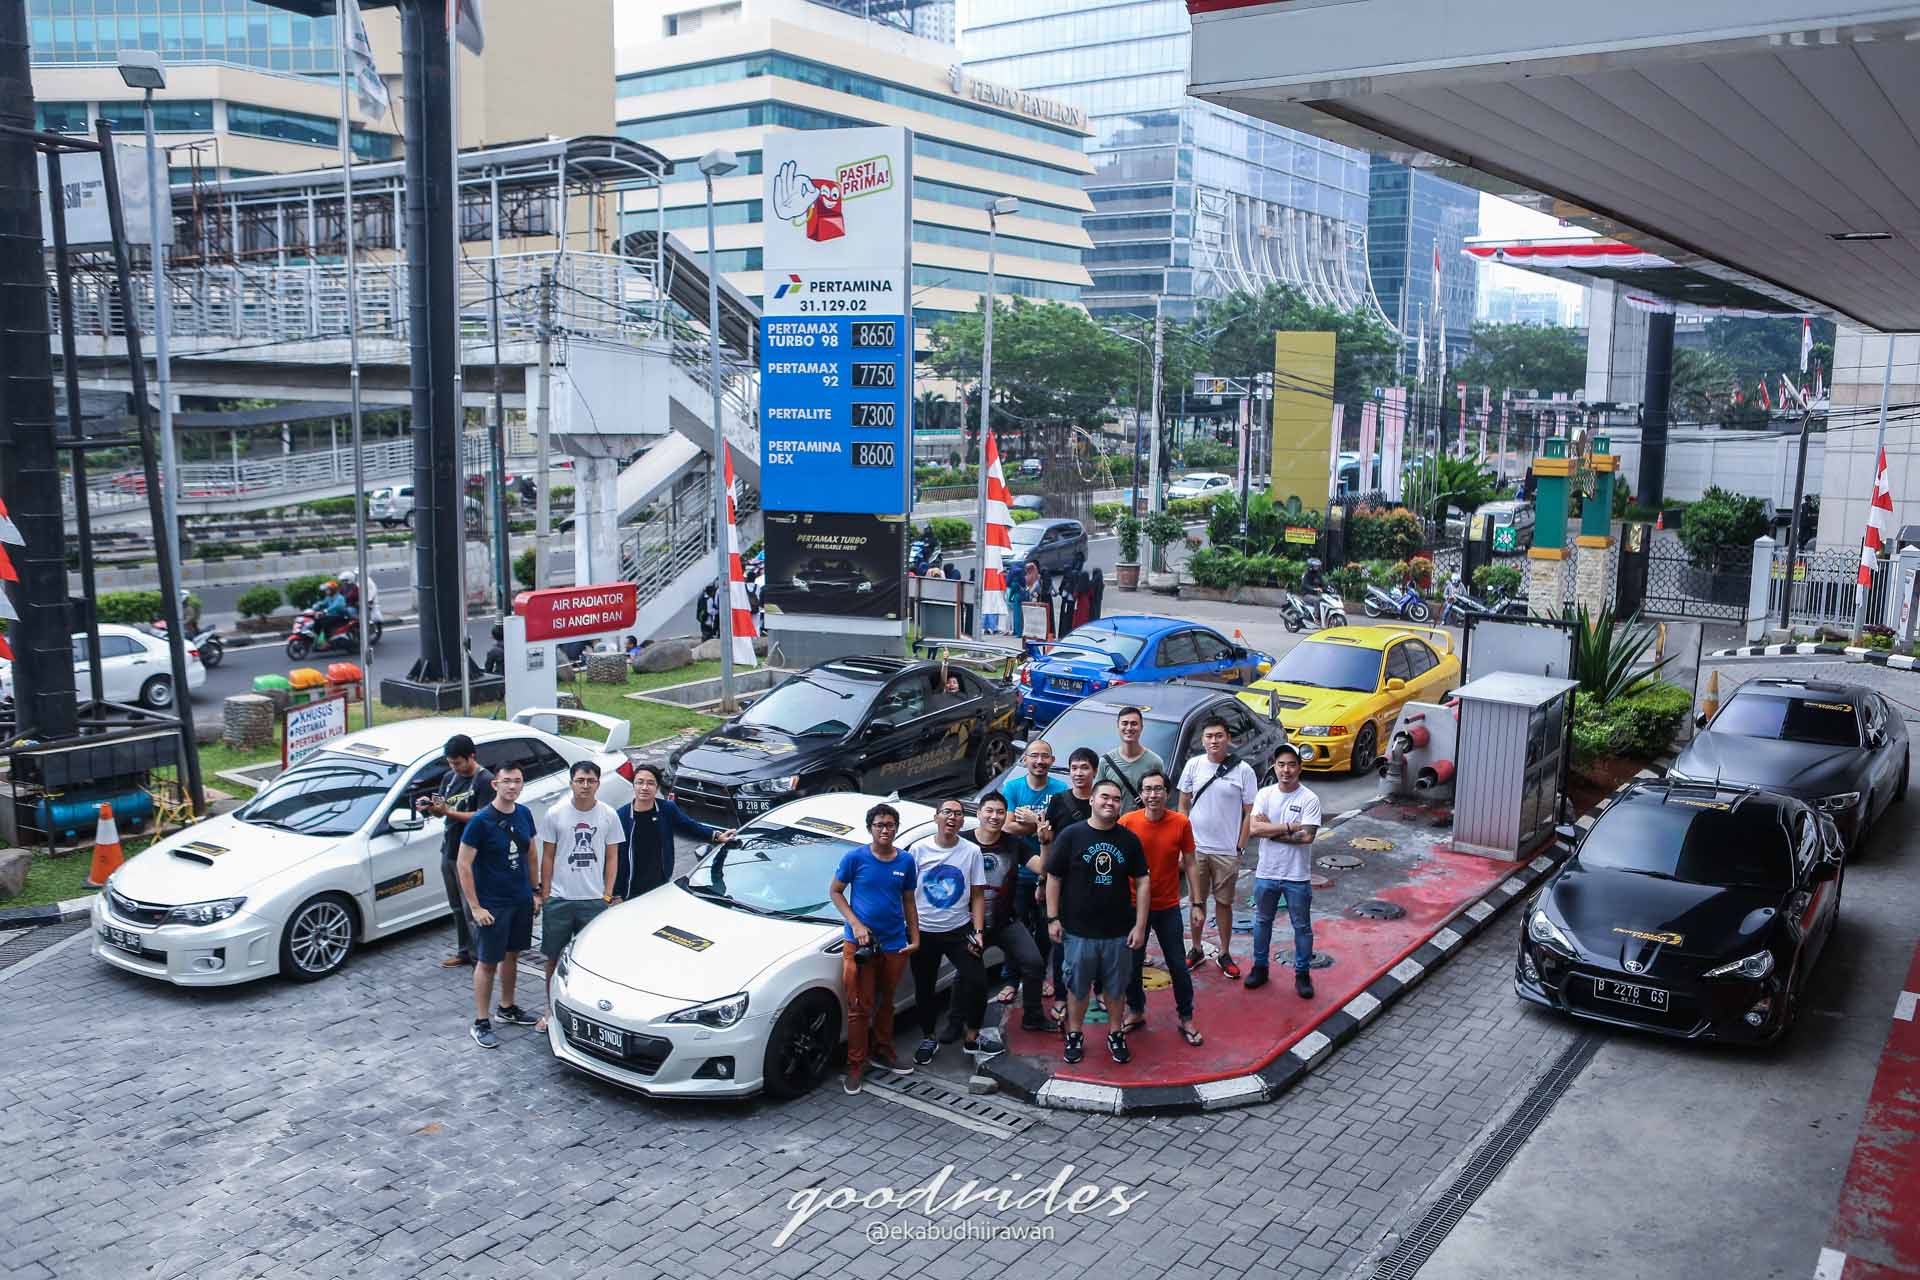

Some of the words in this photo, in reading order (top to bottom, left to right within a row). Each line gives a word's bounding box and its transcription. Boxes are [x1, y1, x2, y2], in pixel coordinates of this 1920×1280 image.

[840, 162, 876, 182] PASTI
[843, 170, 889, 194] PRIMA!
[810, 280, 892, 293] PERTAMINA
[800, 300, 866, 311] 31.129.02
[768, 323, 838, 334] PERTAMAX
[768, 335, 815, 347] TURBO
[822, 335, 838, 347] 98
[860, 326, 894, 346] 8650
[768, 363, 838, 374] PERTAMAX
[860, 365, 894, 385] 7750
[823, 376, 839, 387] 92
[768, 408, 832, 420] PERTALITE
[860, 405, 894, 425] 7300
[768, 441, 842, 453] PERTAMINA
[768, 454, 794, 464] DEX
[860, 445, 894, 465] 8600
[797, 535, 839, 543] PERTAMAX
[840, 536, 867, 544] TURBO
[552, 599, 570, 612] AIR
[572, 593, 624, 609] RADIATOR
[553, 618, 566, 629] ISI
[568, 614, 600, 627] ANGIN
[602, 612, 622, 623] BAN
[300, 704, 333, 720] KHUSUS
[737, 800, 743, 810] B
[1082, 854, 1092, 863] A
[1088, 842, 1124, 864] BATHING
[1095, 875, 1112, 885] APE
[1598, 979, 1605, 990] B
[1614, 983, 1640, 998] 2278
[1651, 990, 1665, 1003] GS
[572, 1018, 578, 1030] B
[587, 1023, 591, 1036] 1
